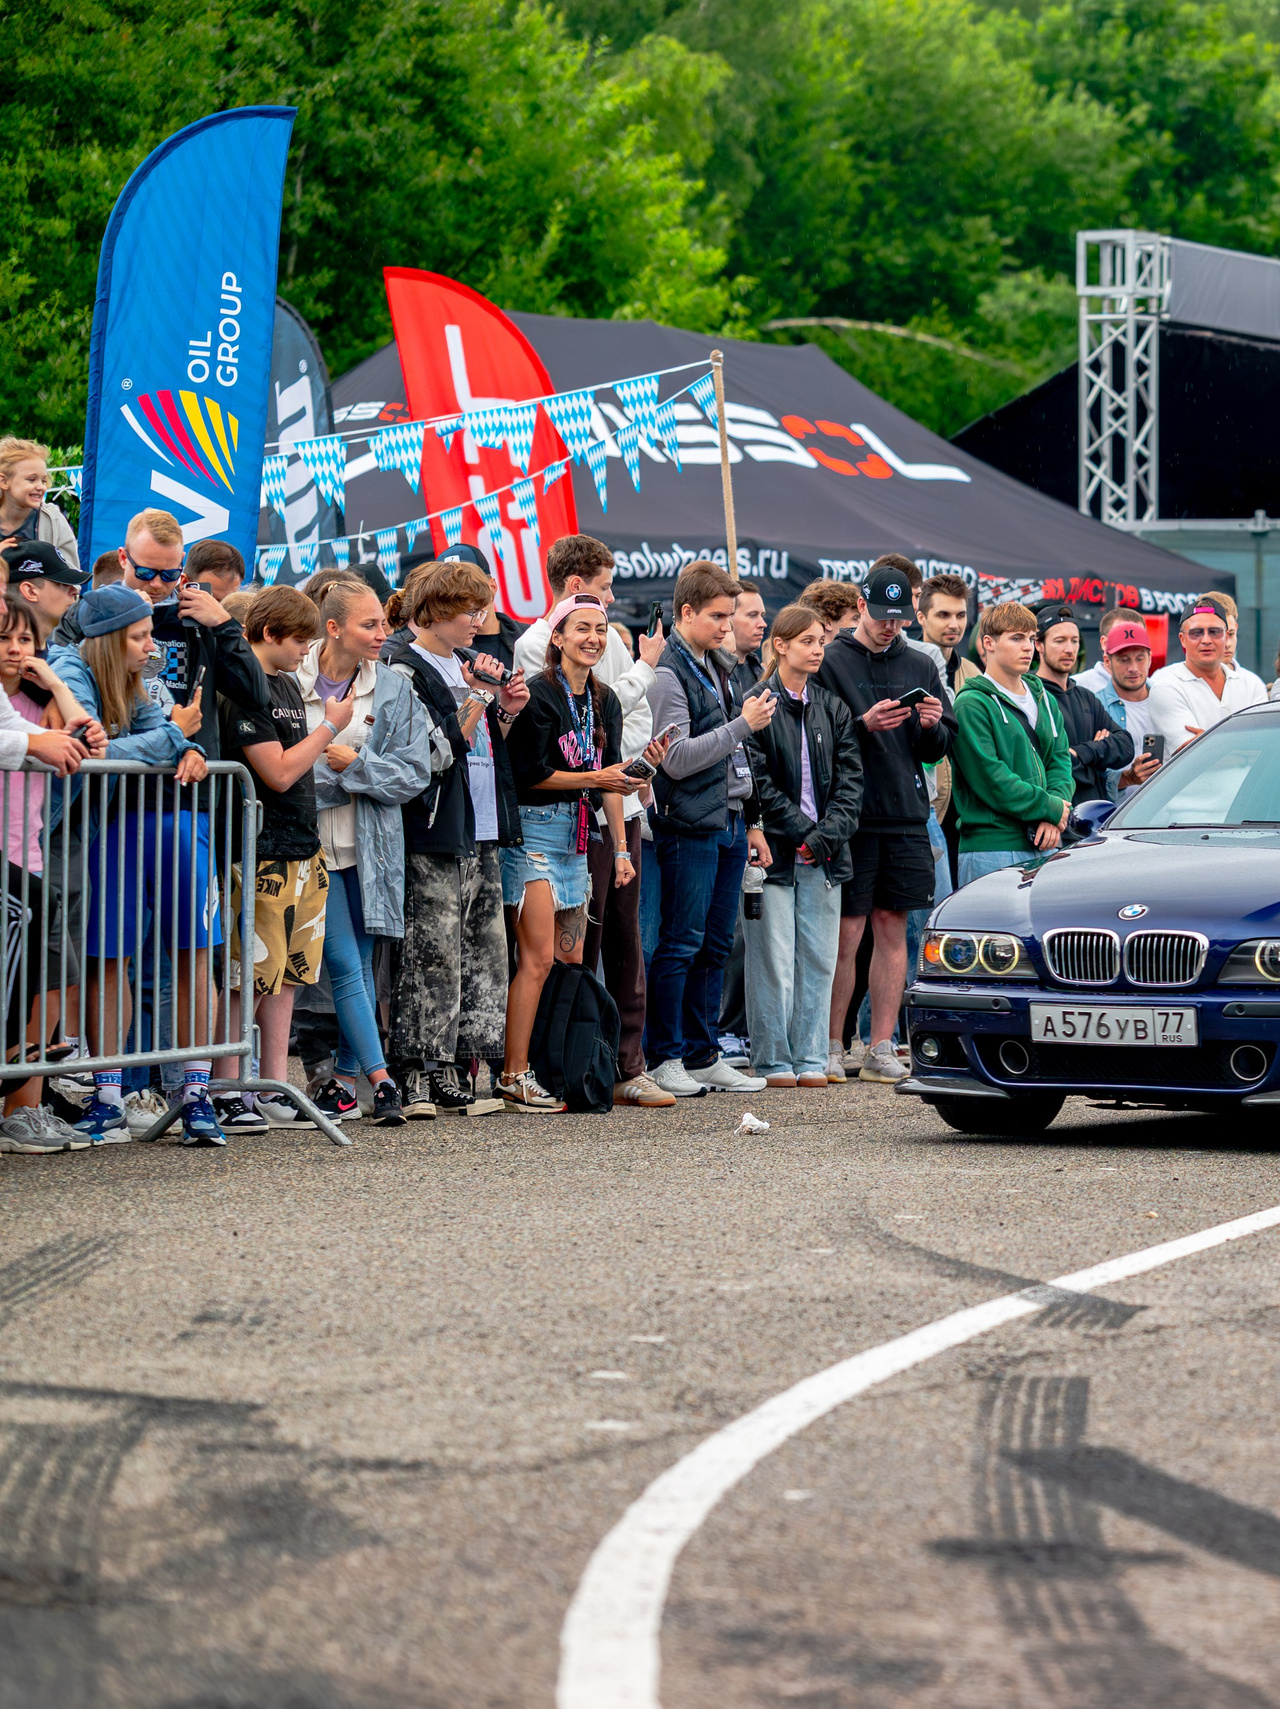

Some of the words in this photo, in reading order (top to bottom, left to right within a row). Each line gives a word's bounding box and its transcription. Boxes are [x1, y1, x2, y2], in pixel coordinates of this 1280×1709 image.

[216, 271, 243, 387] GROUP
[187, 330, 212, 383] OIL
[165, 680, 188, 690] Machin
[288, 950, 310, 978] NIKE
[1043, 1010, 1149, 1041] А576УВ
[1157, 1011, 1185, 1034] 77
[1161, 1034, 1184, 1044] RUS
